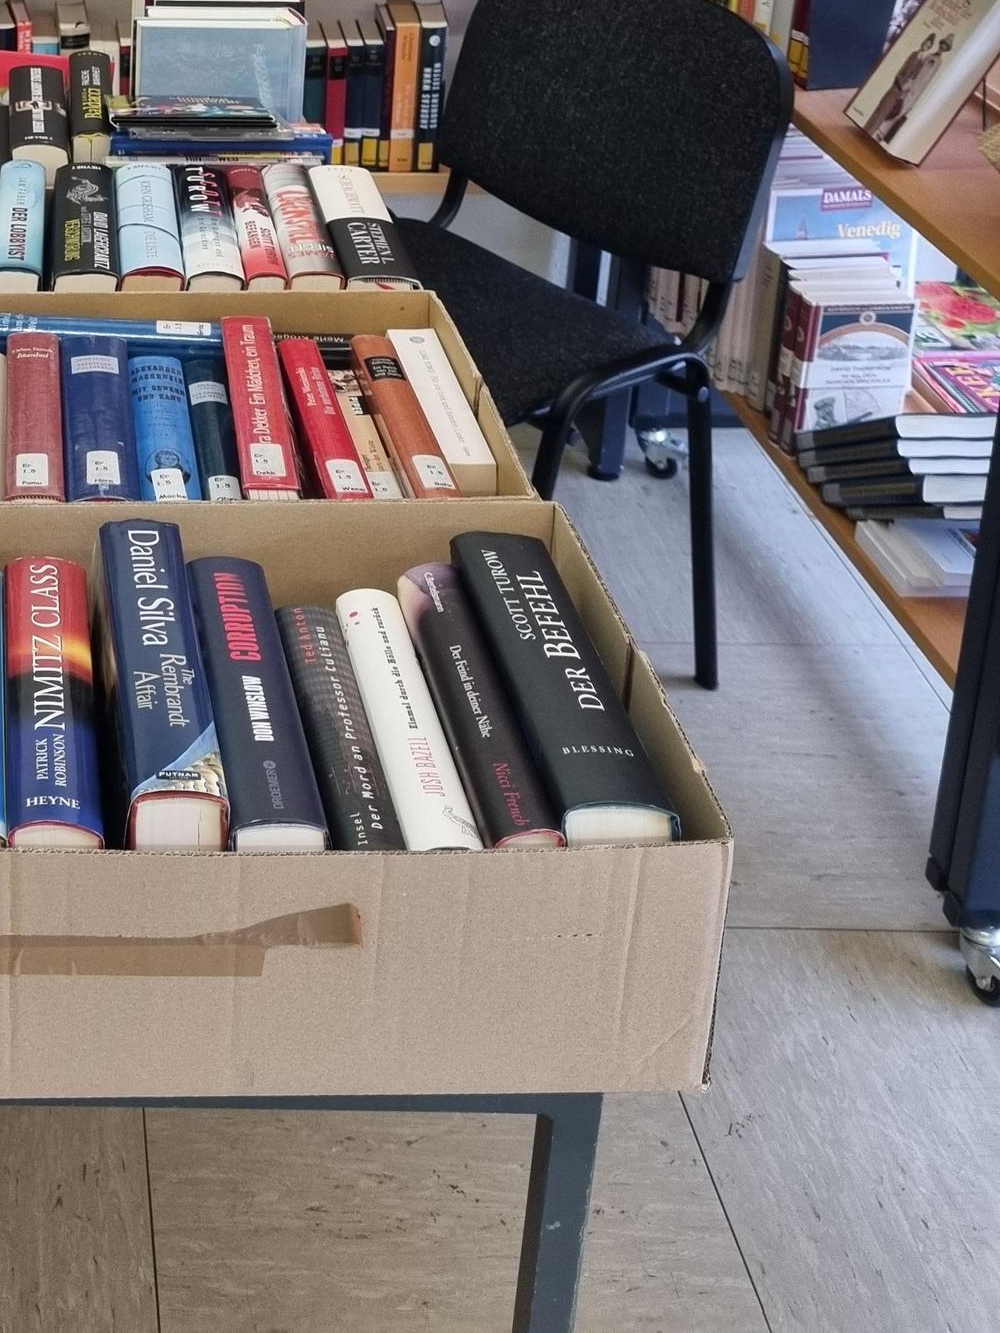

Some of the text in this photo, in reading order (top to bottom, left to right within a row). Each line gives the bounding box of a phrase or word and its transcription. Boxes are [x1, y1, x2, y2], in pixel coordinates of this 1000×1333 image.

[186, 168, 209, 213] TUROW
[824, 189, 871, 204] DAMALS
[8, 207, 28, 261] DER LOBBYIST
[348, 223, 379, 265] CARTER
[838, 222, 900, 239] Venedig
[128, 530, 175, 645] Daniel Silva
[481, 548, 536, 640] SCOTT TUROW
[215, 573, 262, 662] CORRUPTION
[30, 565, 65, 729] NIMITZ CLASS
[450, 645, 461, 660] Der
[516, 570, 605, 712] DER BEFEHL
[134, 671, 152, 709] Affair
[159, 653, 187, 727] Rembrandt
[177, 668, 194, 684] The
[454, 661, 469, 681] Feind
[242, 676, 274, 742] DON WINSLOW
[466, 690, 482, 716] deiner
[316, 627, 384, 830] Der Mord an Professor Culianu
[476, 716, 491, 739] Nähe
[36, 739, 48, 780] PATRICK
[55, 734, 66, 787] ROBINSON
[408, 737, 446, 797] JOSH BAZELL
[562, 746, 634, 757] BLESSING
[26, 796, 80, 810] HEYNE
[493, 763, 530, 826] Nicci French
[354, 812, 369, 846] Insel
